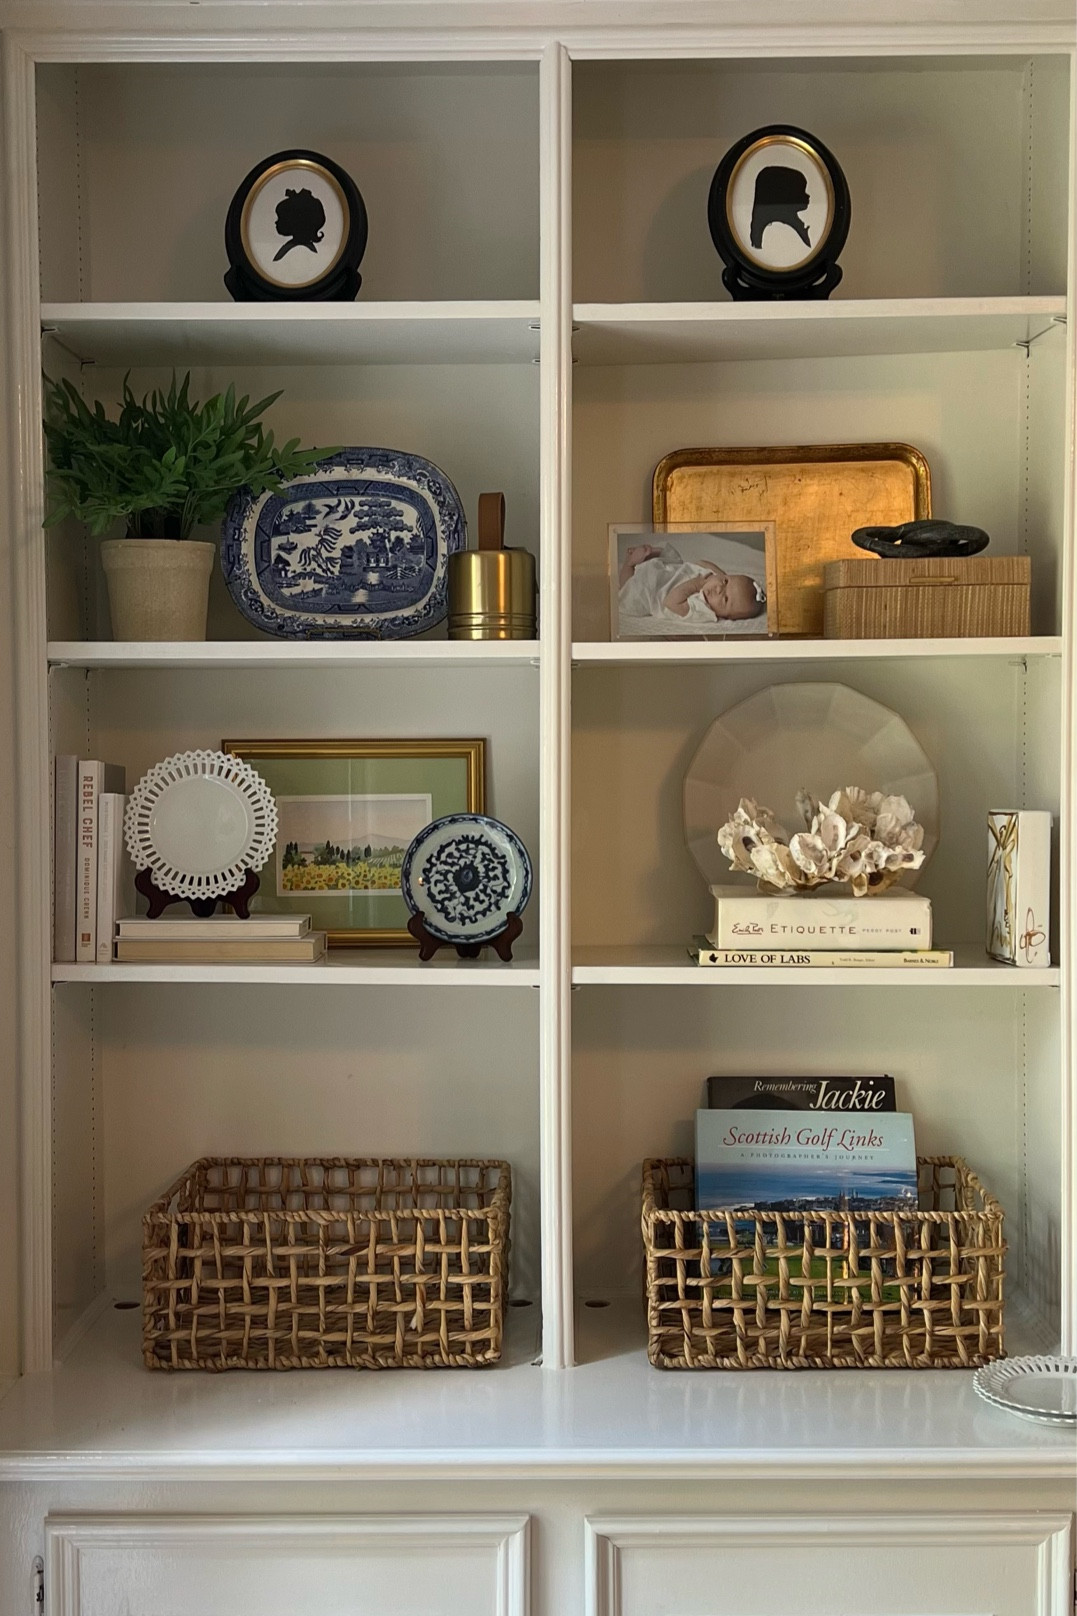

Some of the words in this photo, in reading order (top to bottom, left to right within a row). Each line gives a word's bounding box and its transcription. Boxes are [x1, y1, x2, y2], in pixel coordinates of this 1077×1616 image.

[82, 775, 93, 812] REBEL
[82, 817, 93, 848] CHEF
[770, 923, 856, 935] ETIQUETTE
[724, 953, 757, 963] LOVE
[760, 954, 777, 964] OF
[780, 954, 811, 964] LABS
[754, 1080, 817, 1093] Remembering
[810, 1080, 886, 1110] Jackie
[723, 1126, 791, 1147] Scottish
[796, 1128, 838, 1152] Golf
[837, 1129, 884, 1151] Links
